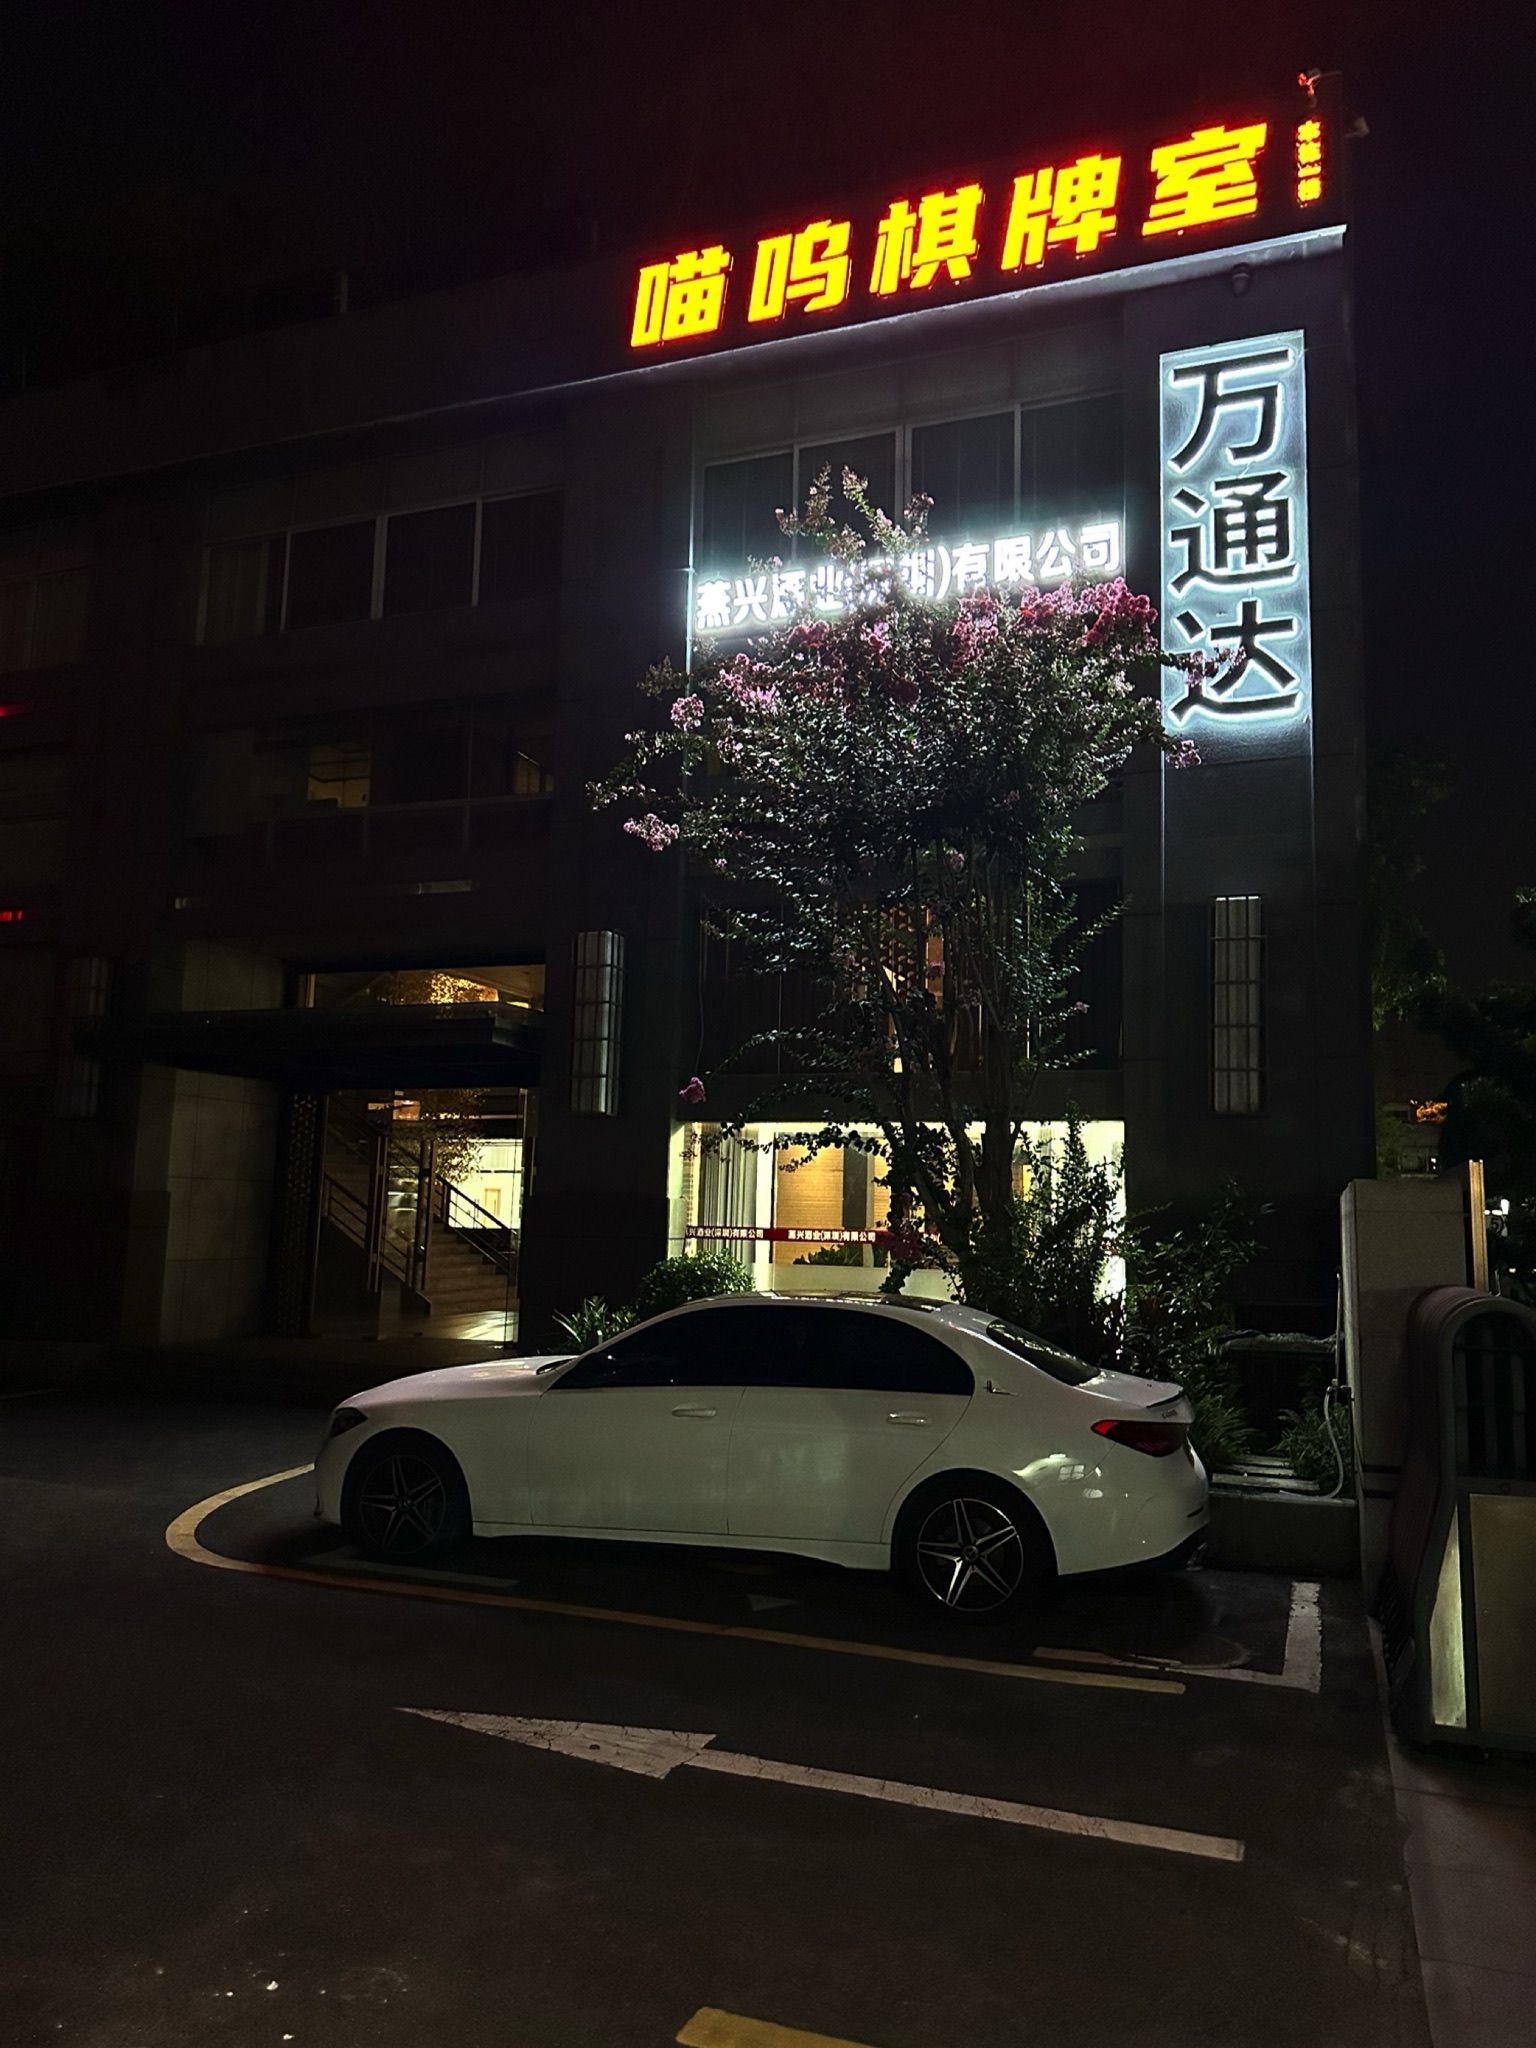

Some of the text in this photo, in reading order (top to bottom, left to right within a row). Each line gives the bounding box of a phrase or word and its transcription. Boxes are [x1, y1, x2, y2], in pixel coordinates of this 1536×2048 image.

[631, 122, 1267, 347] 喵呜棋牌室
[1168, 348, 1298, 727] 万通达
